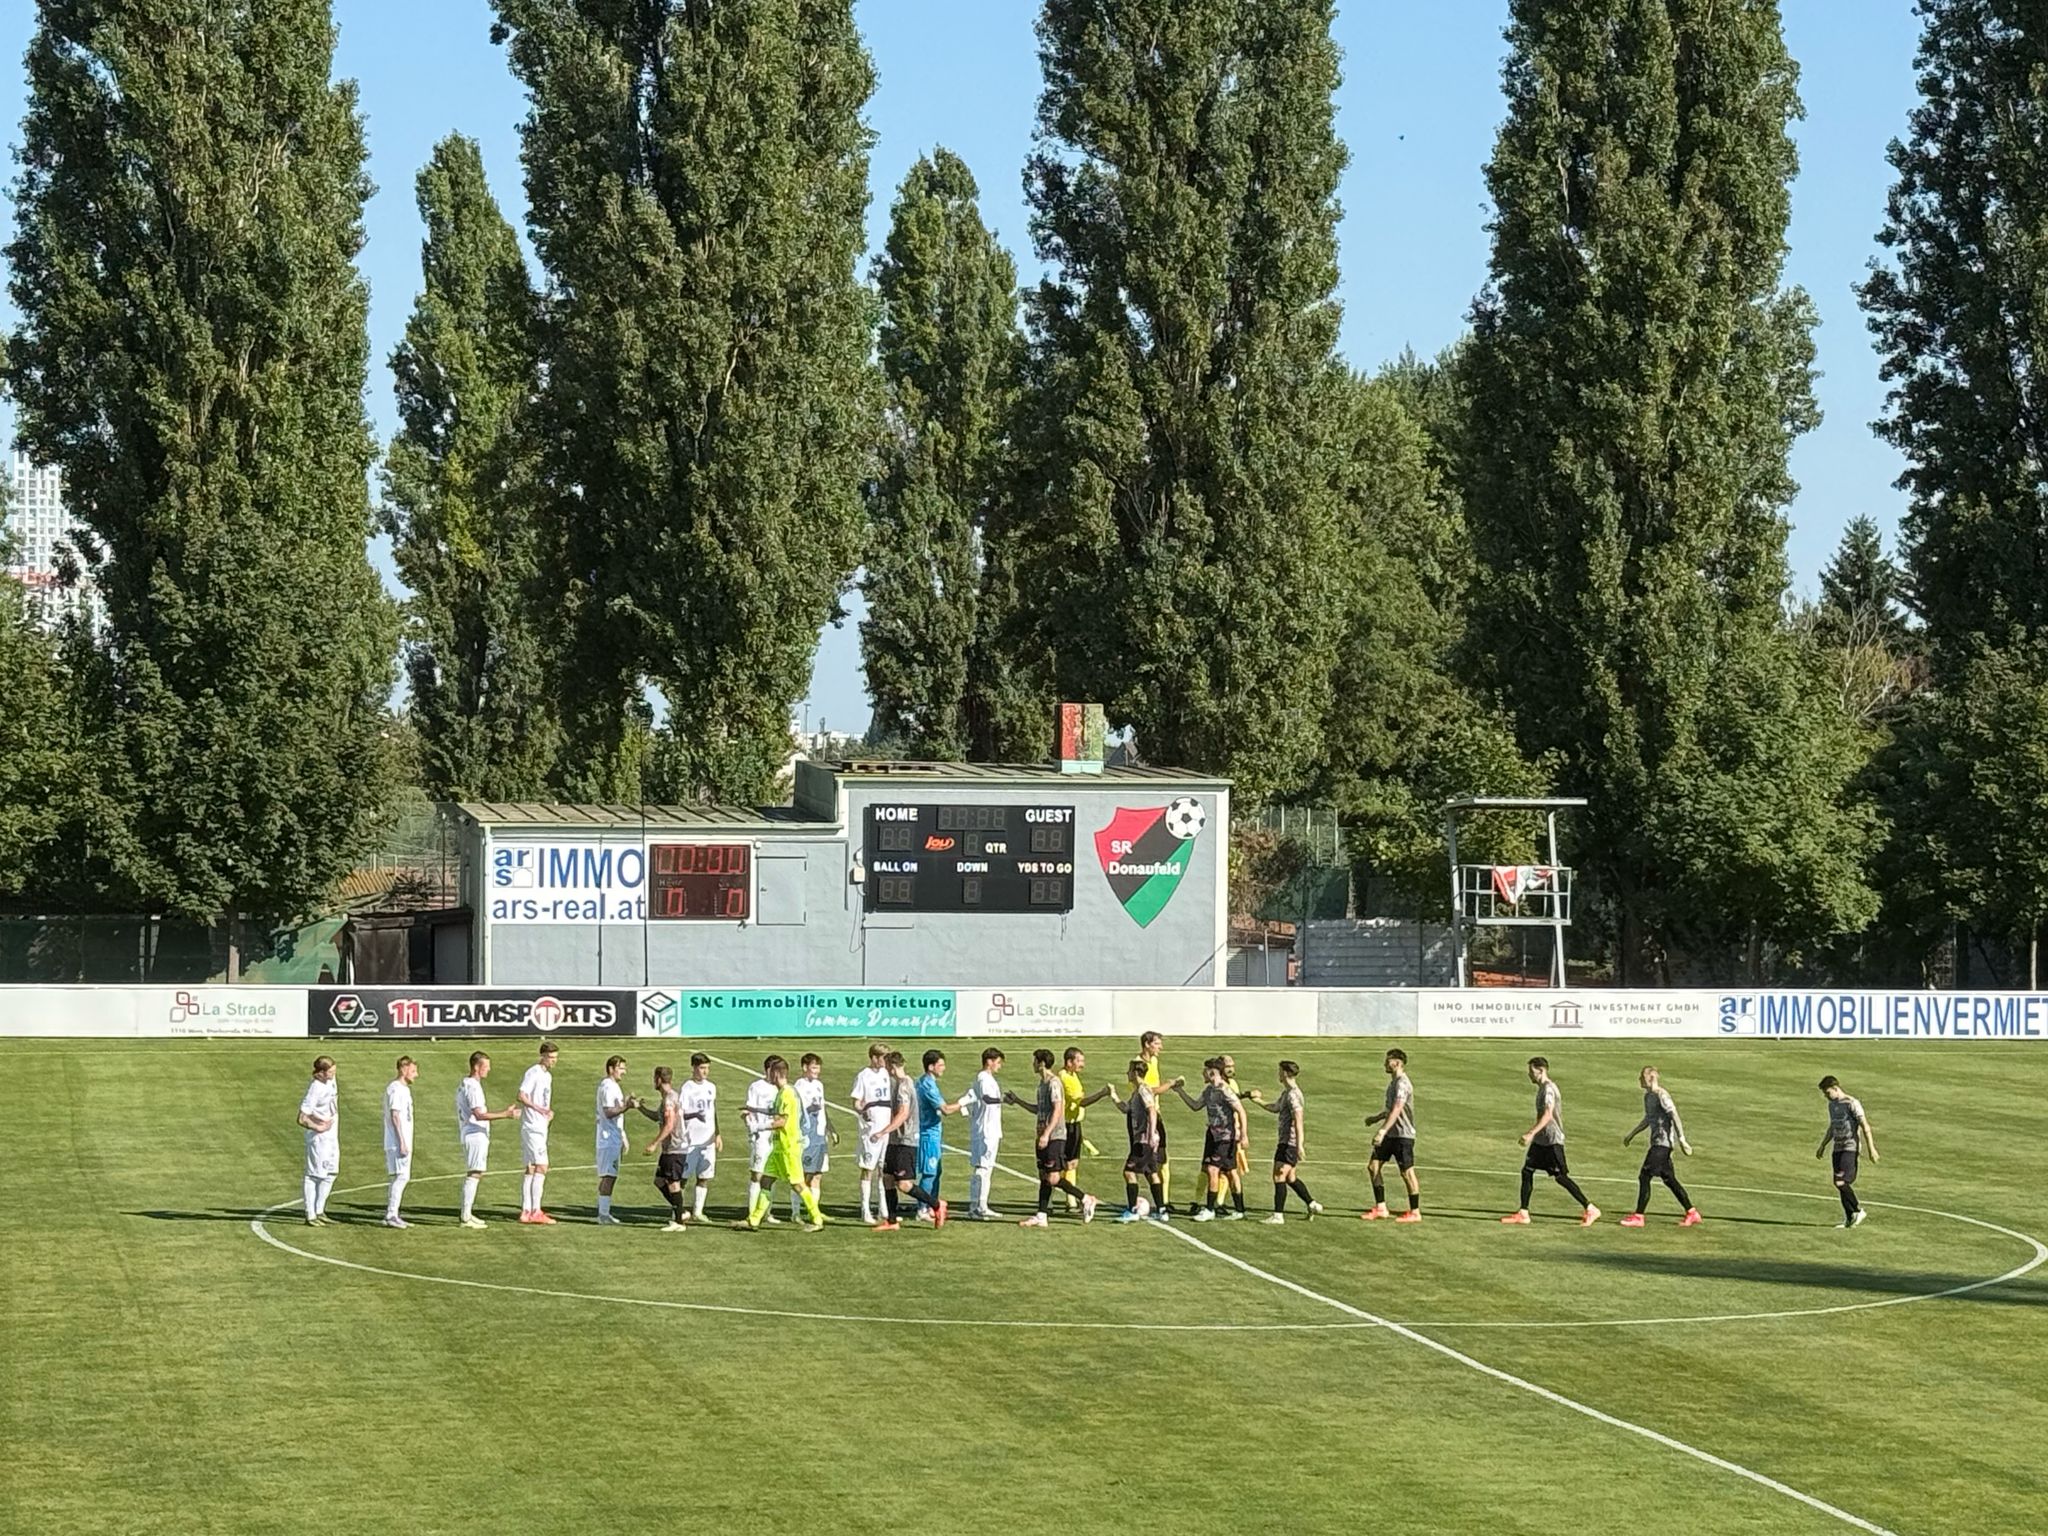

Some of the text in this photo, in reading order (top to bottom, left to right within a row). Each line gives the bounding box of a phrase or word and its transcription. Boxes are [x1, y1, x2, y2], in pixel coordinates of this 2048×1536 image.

[875, 808, 918, 821] HOME
[1025, 809, 1072, 823] GUEST
[985, 842, 1007, 855] QTR
[1110, 840, 1133, 854] SR
[538, 848, 645, 888] IMMO
[873, 862, 918, 873] BALL ON
[957, 862, 988, 873] DOWN
[1017, 862, 1072, 873] YDS TO GO
[1108, 861, 1181, 875] Donaufeld
[493, 893, 646, 920] ars-real.at
[202, 1003, 276, 1016] La Strada
[689, 995, 952, 1011] SNC Immobilien Vermietung
[1017, 1003, 1085, 1016] La Strada
[1471, 1002, 1542, 1011] IMMOBILIEN
[1589, 1003, 1661, 1012] INVESTMENT
[1490, 1016, 1515, 1024] WELT
[1626, 1017, 1682, 1025] DONAUFELD
